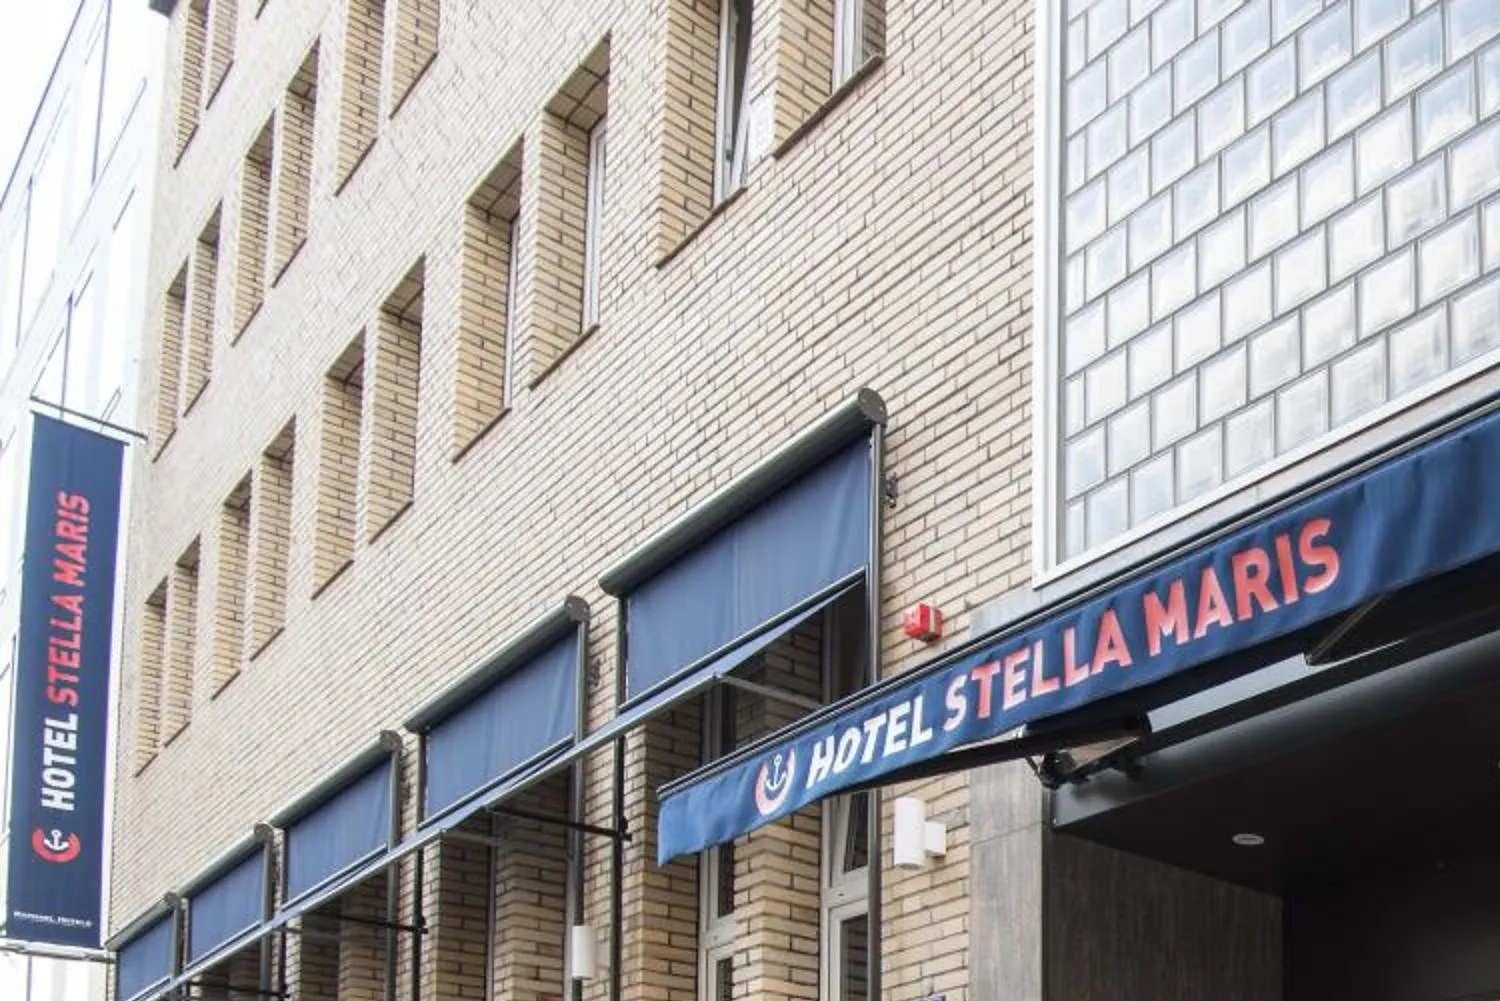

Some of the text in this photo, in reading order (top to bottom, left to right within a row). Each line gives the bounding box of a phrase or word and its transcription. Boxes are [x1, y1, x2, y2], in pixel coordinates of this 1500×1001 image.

[41, 490, 90, 812] HOTEL STELLA MARIS
[806, 517, 1340, 790] HOTEL STELLA MARIS
